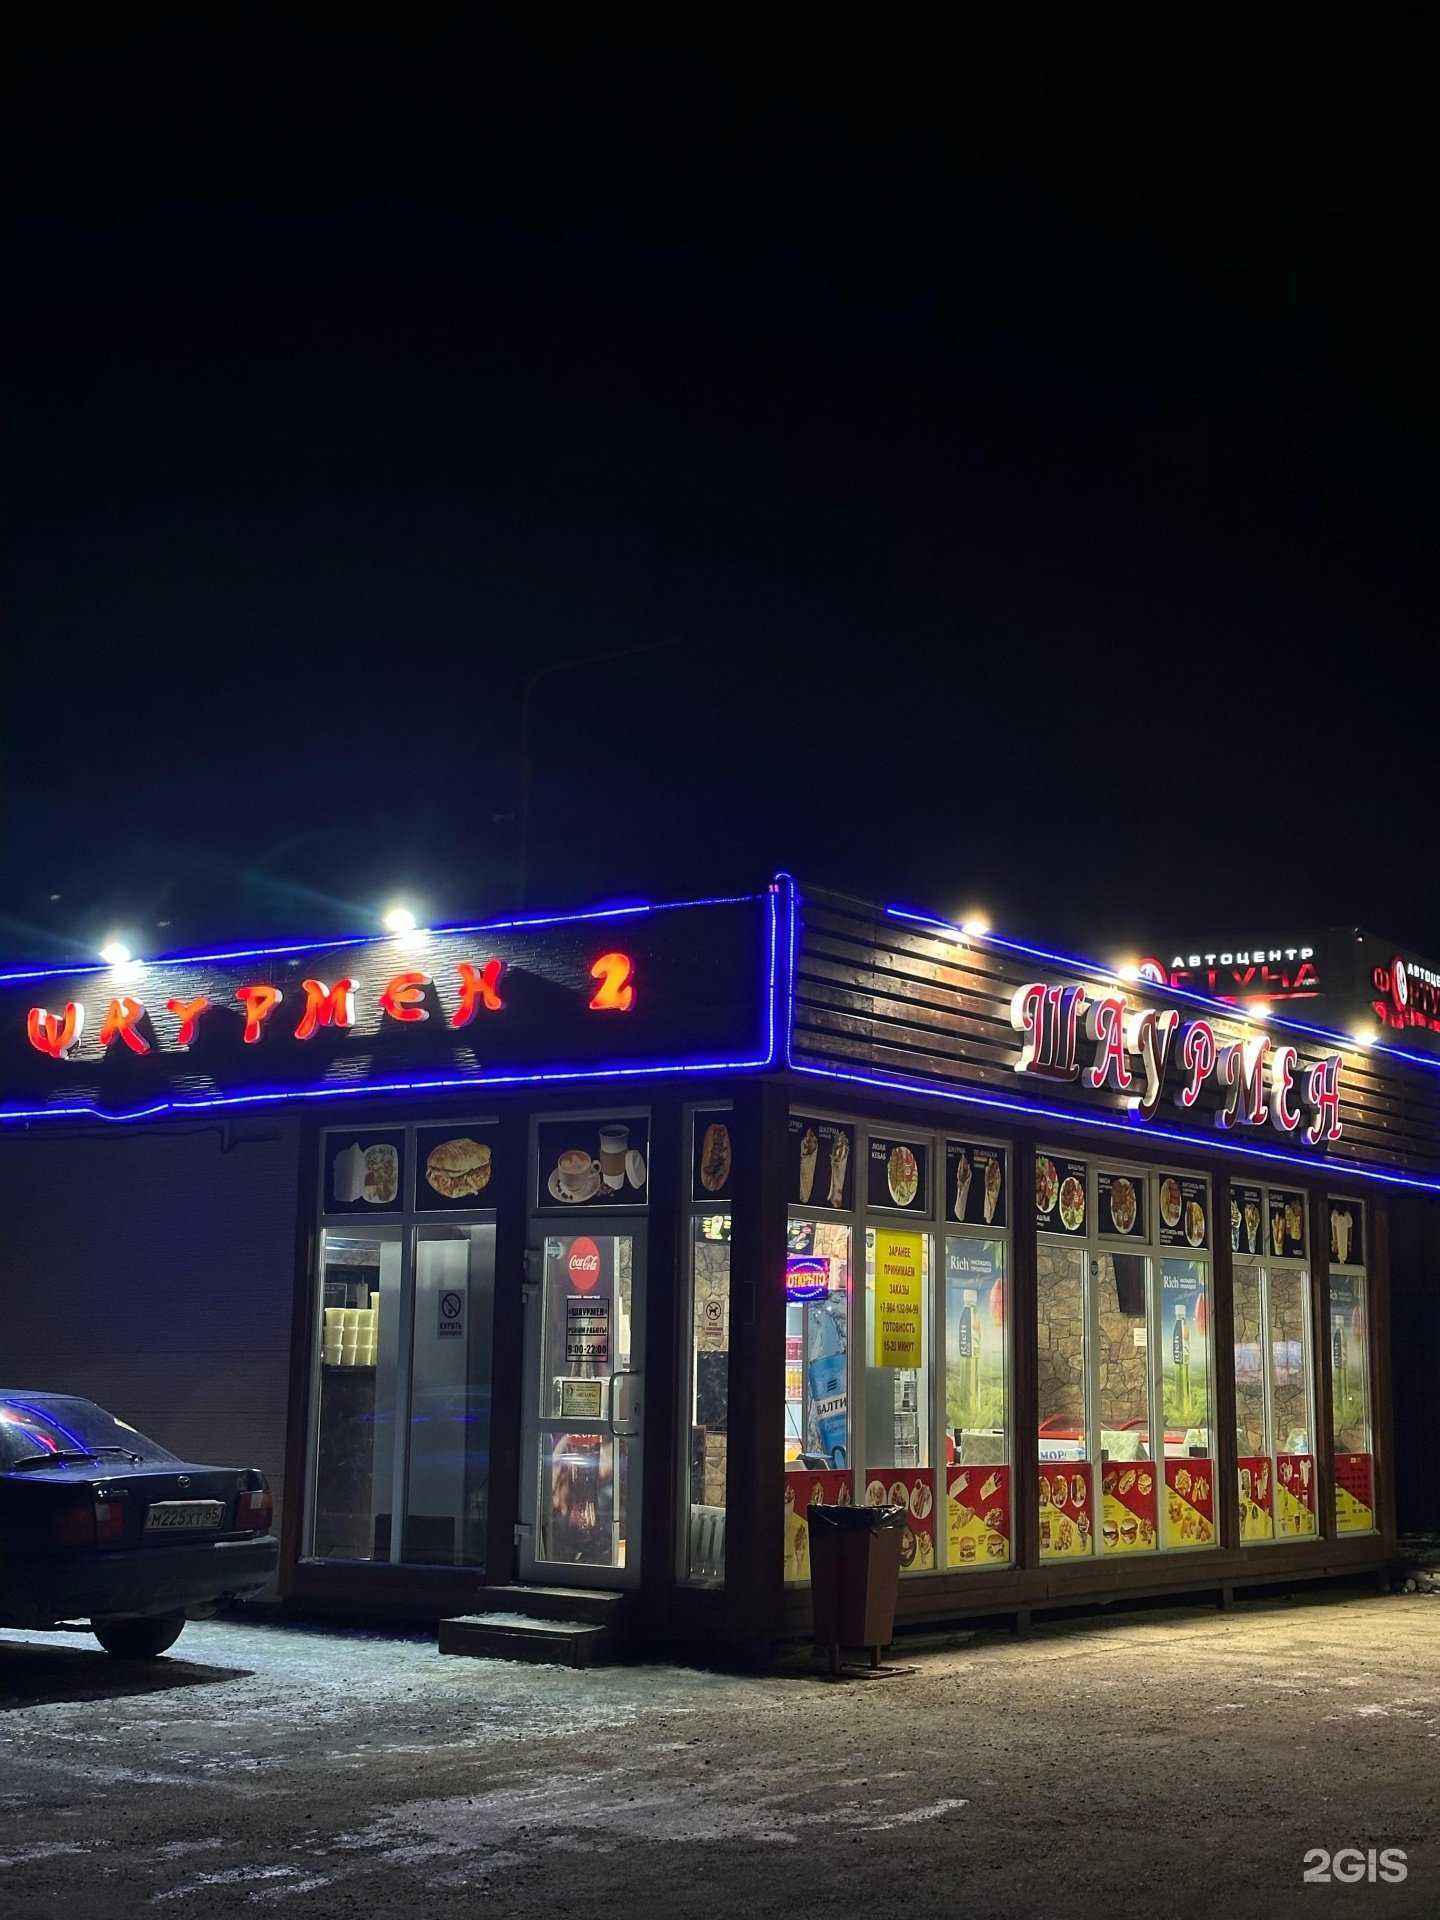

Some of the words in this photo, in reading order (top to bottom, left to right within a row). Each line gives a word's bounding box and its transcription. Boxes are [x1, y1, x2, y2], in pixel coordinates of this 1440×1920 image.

[1171, 947, 1314, 968] АВТОЦЕНТР
[588, 952, 637, 1012] 2
[1010, 983, 1344, 1145] ШАУРМЕН
[888, 1246, 912, 1258] ЗАРАНЕЕ
[950, 1255, 970, 1272] Rich
[889, 1284, 910, 1296] ЗАКАЗЫ
[1163, 1275, 1179, 1289] Rich
